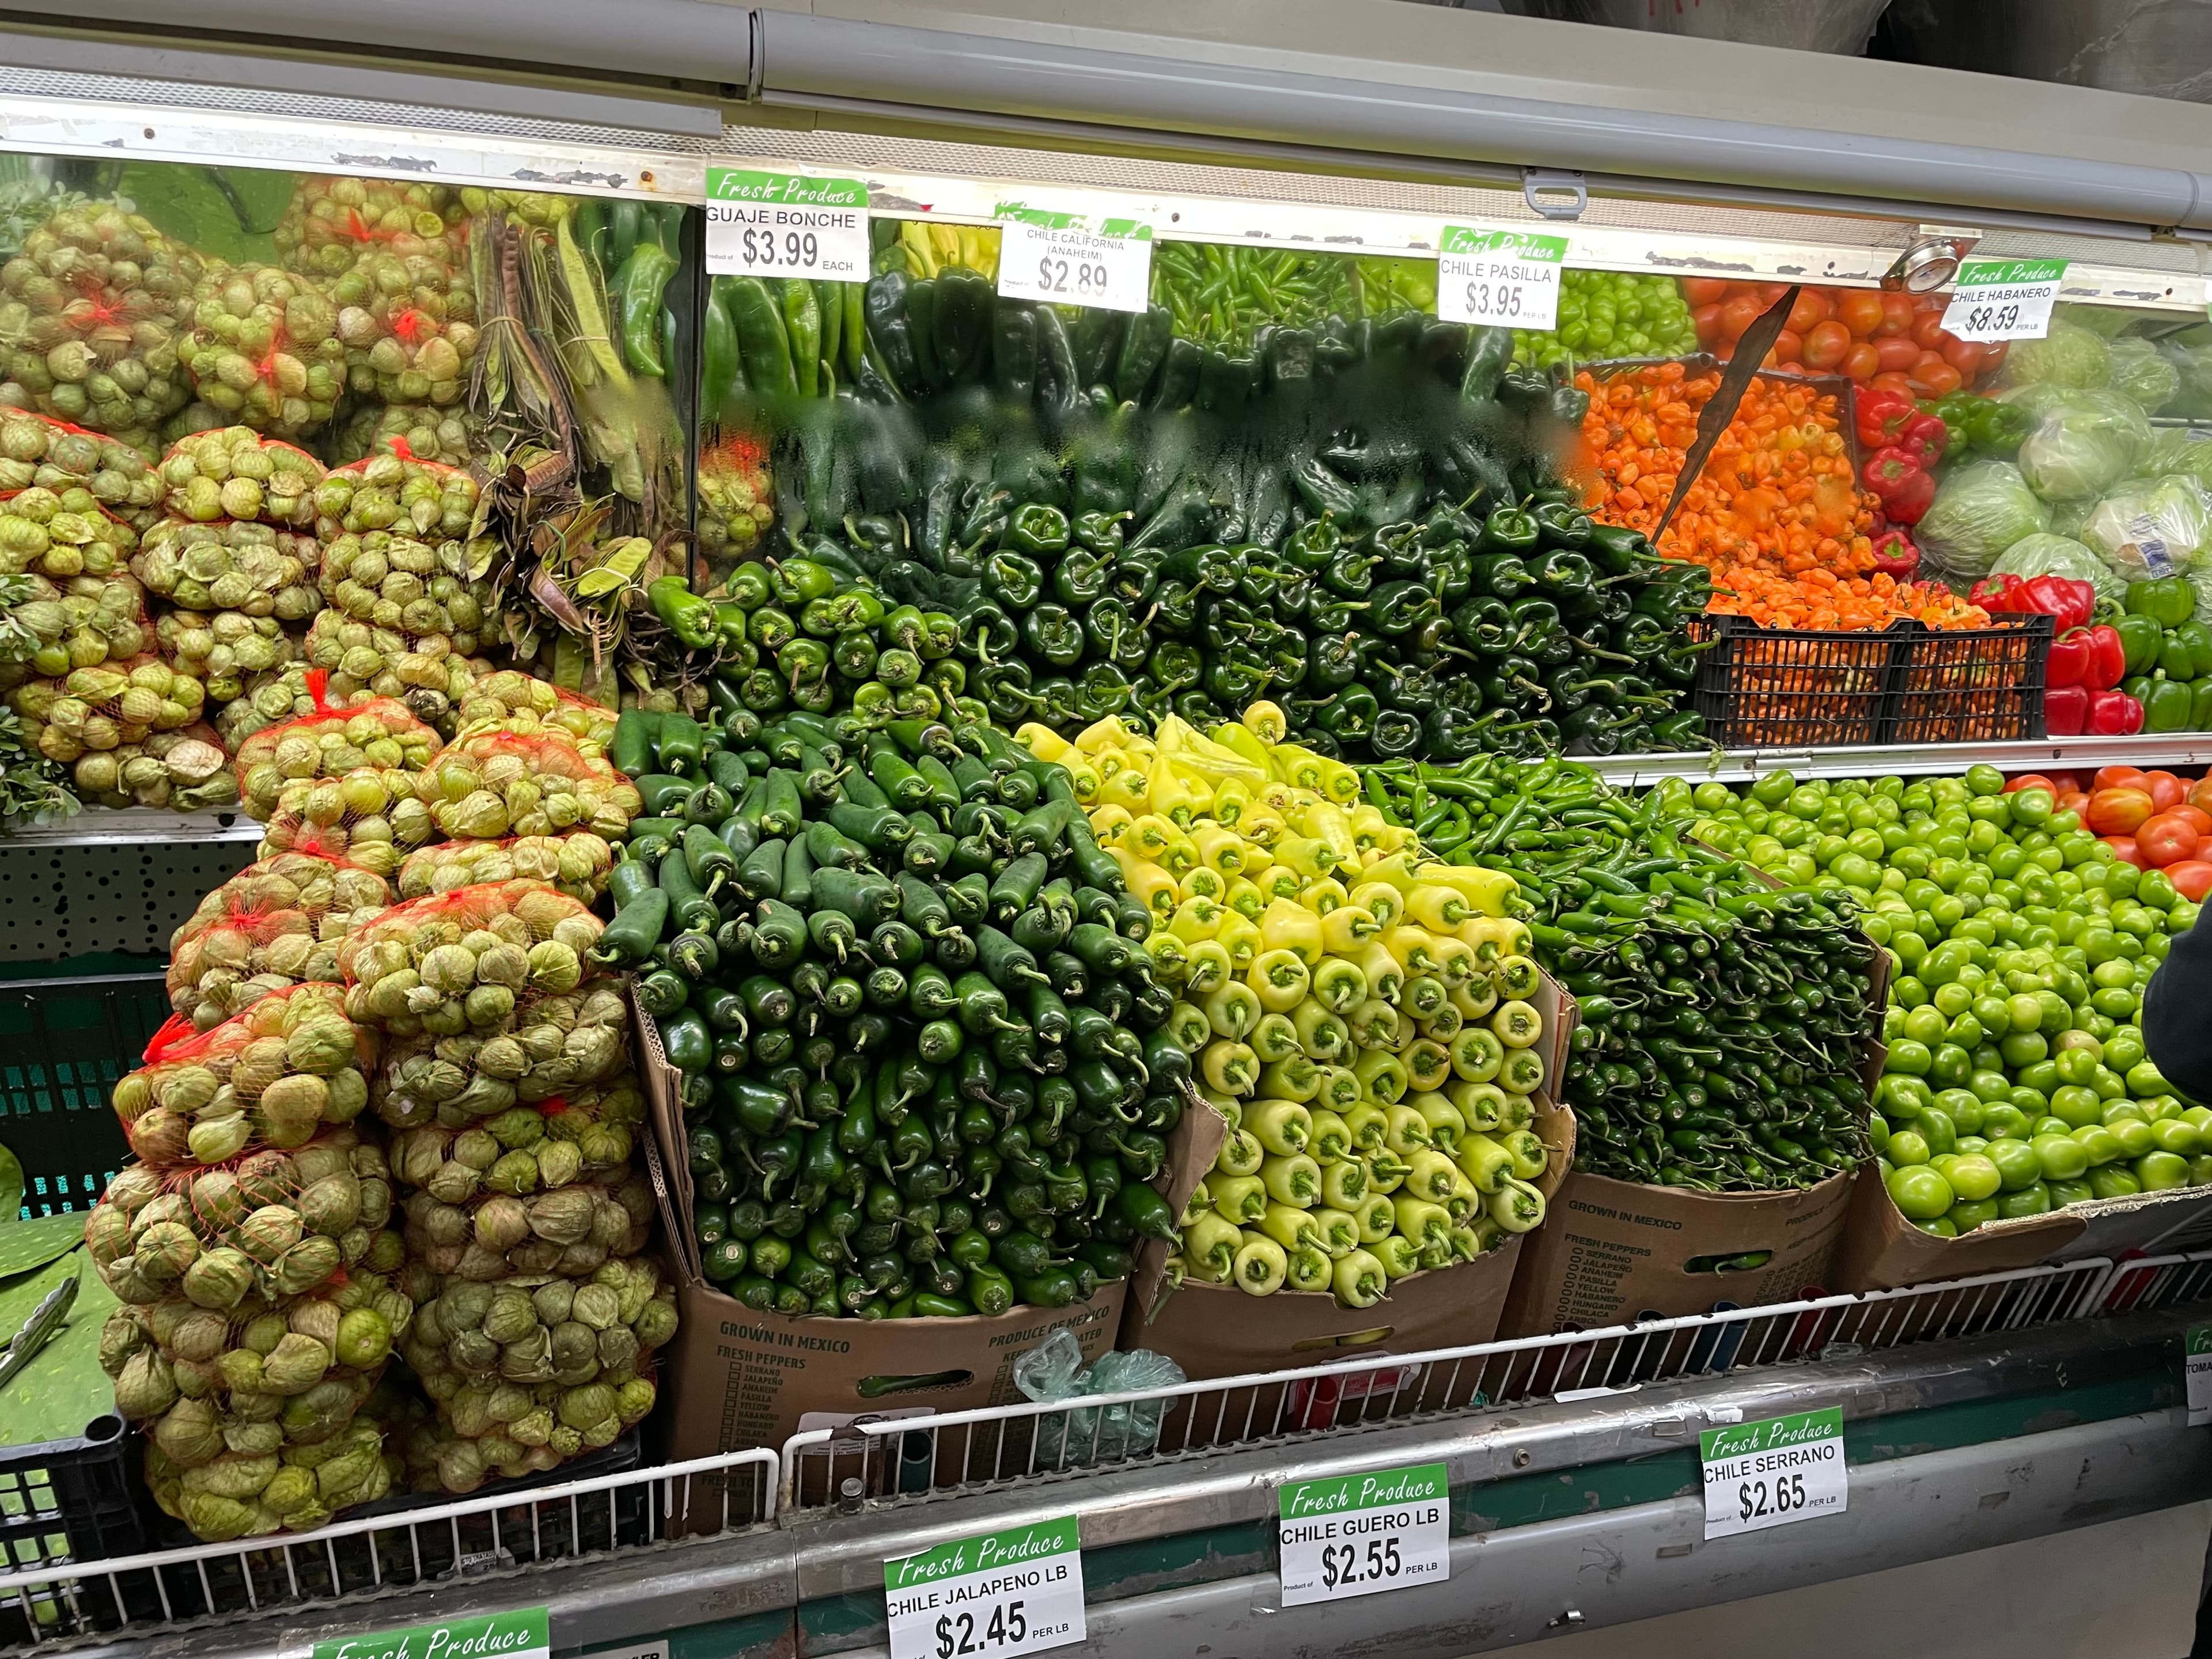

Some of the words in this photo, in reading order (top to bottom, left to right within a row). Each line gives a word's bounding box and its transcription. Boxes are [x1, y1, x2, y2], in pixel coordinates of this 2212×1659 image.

[717, 173, 785, 199] Fresh
[783, 178, 856, 203] Produce
[707, 207, 769, 224] GUAJE
[777, 211, 855, 229] BONCHE
[743, 228, 817, 267] $3.99
[1027, 229, 1058, 241] CHILE
[1061, 234, 1124, 250] CALIFORNIA
[1449, 230, 1493, 253] Fresh
[1047, 246, 1103, 262] (ANAHEIM)
[823, 261, 853, 271] EACH
[1038, 256, 1107, 297] $2.89
[1441, 260, 1484, 276] CHILE
[1490, 264, 1551, 283] PASILLA
[1964, 265, 2006, 283] Fresh
[2007, 264, 2056, 281] Produce
[1466, 281, 1522, 316] $3.95
[1952, 291, 1985, 302] CHILE
[1987, 287, 2050, 301] HABANERO
[1965, 305, 2019, 335] $8.59
[1569, 1200, 1616, 1219] GROWN
[1619, 1211, 1632, 1222] IN
[1634, 1215, 1682, 1230] MEXICO
[1565, 1233, 1600, 1248] FRESH
[1603, 1242, 1652, 1256] PEPPERS
[1586, 1250, 1631, 1263] SERRANO
[1578, 1283, 1616, 1294] YELLOW
[1580, 1275, 1617, 1286] PASILLA
[1575, 1291, 1625, 1303] HABANERO
[721, 1321, 774, 1343] GROWN
[778, 1333, 794, 1347] IN
[797, 1335, 850, 1354] MEXICO
[988, 1325, 1046, 1347] PRODUCE
[1066, 1305, 1110, 1328] MEXICO
[717, 1346, 753, 1362] FRESH
[756, 1353, 806, 1369] PEPPERS
[745, 1365, 780, 1376] SERRANO
[1710, 1427, 1759, 1457] Fresh
[1767, 1418, 1832, 1447] Produce
[1705, 1460, 1751, 1483] CHILE
[1756, 1445, 1835, 1472] SERRANO
[1291, 1482, 1349, 1515] Fresh
[1359, 1475, 1435, 1506] Produce
[1739, 1474, 1805, 1524] $2.65
[1809, 1498, 1824, 1508] PER
[1281, 1522, 1336, 1544] CHILE
[1343, 1512, 1410, 1535] GUERO
[1416, 1508, 1439, 1525] LB
[898, 1546, 965, 1584] Fresh
[977, 1531, 1064, 1568] Produce
[1322, 1537, 1400, 1592] $2.55
[1406, 1565, 1423, 1575] PER
[1426, 1562, 1438, 1571] LB
[888, 1593, 940, 1617] CHILE
[945, 1571, 1040, 1604] JALAPENO
[1046, 1565, 1067, 1583] LB
[1283, 1583, 1306, 1591] Product
[425, 1622, 531, 1659] Produce
[935, 1600, 1027, 1659] $2.45
[1033, 1626, 1053, 1639] PER
[1056, 1623, 1069, 1633] LB
